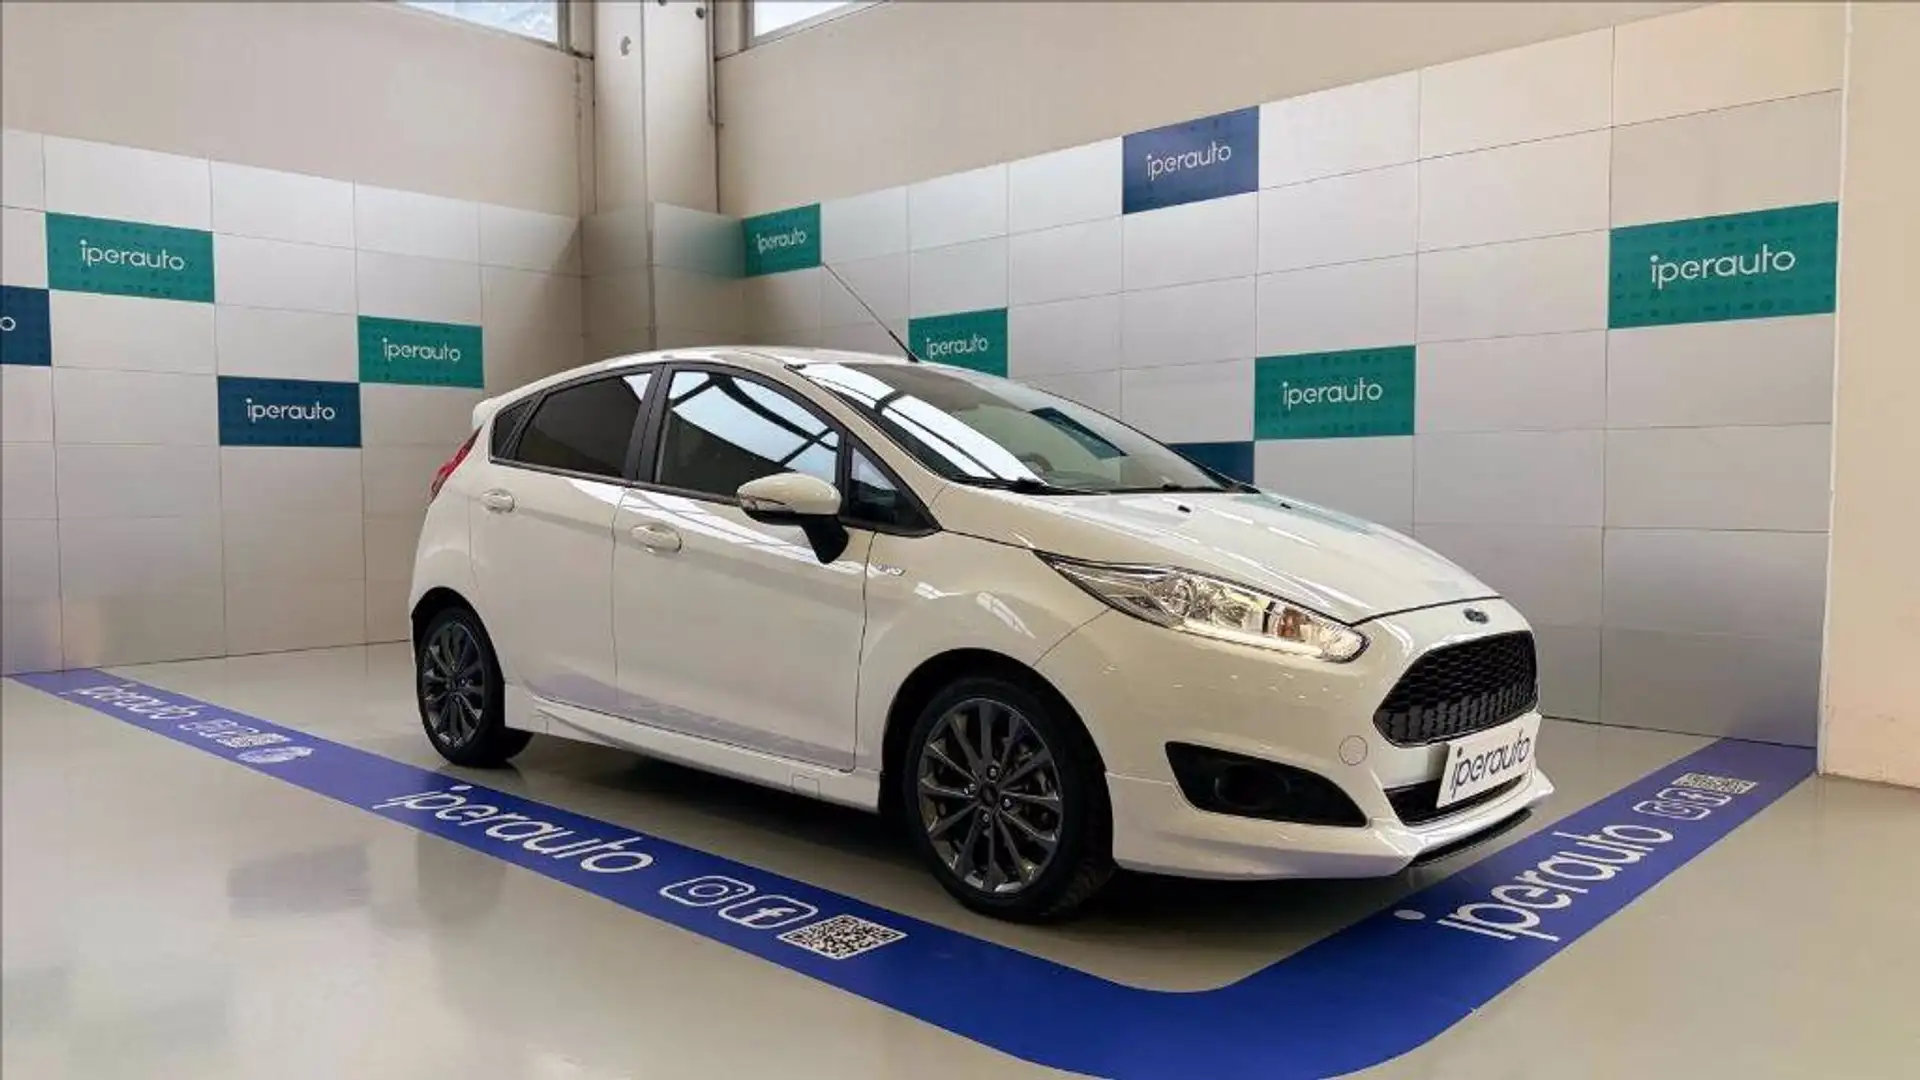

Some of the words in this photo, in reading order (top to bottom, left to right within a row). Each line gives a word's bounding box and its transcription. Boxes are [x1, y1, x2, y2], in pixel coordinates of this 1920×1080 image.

[1145, 141, 1232, 181] iperauto
[79, 239, 185, 272] iperauto
[756, 228, 808, 254] iperauto
[1650, 243, 1796, 290] iperauto
[382, 337, 461, 362] iperauto
[926, 334, 988, 359] iperauto
[1282, 376, 1384, 411] iperauto
[246, 398, 336, 429] iperauto
[1449, 726, 1531, 800] iperauto
[372, 785, 654, 873] iperauto
[1393, 824, 1675, 942] iperauto
